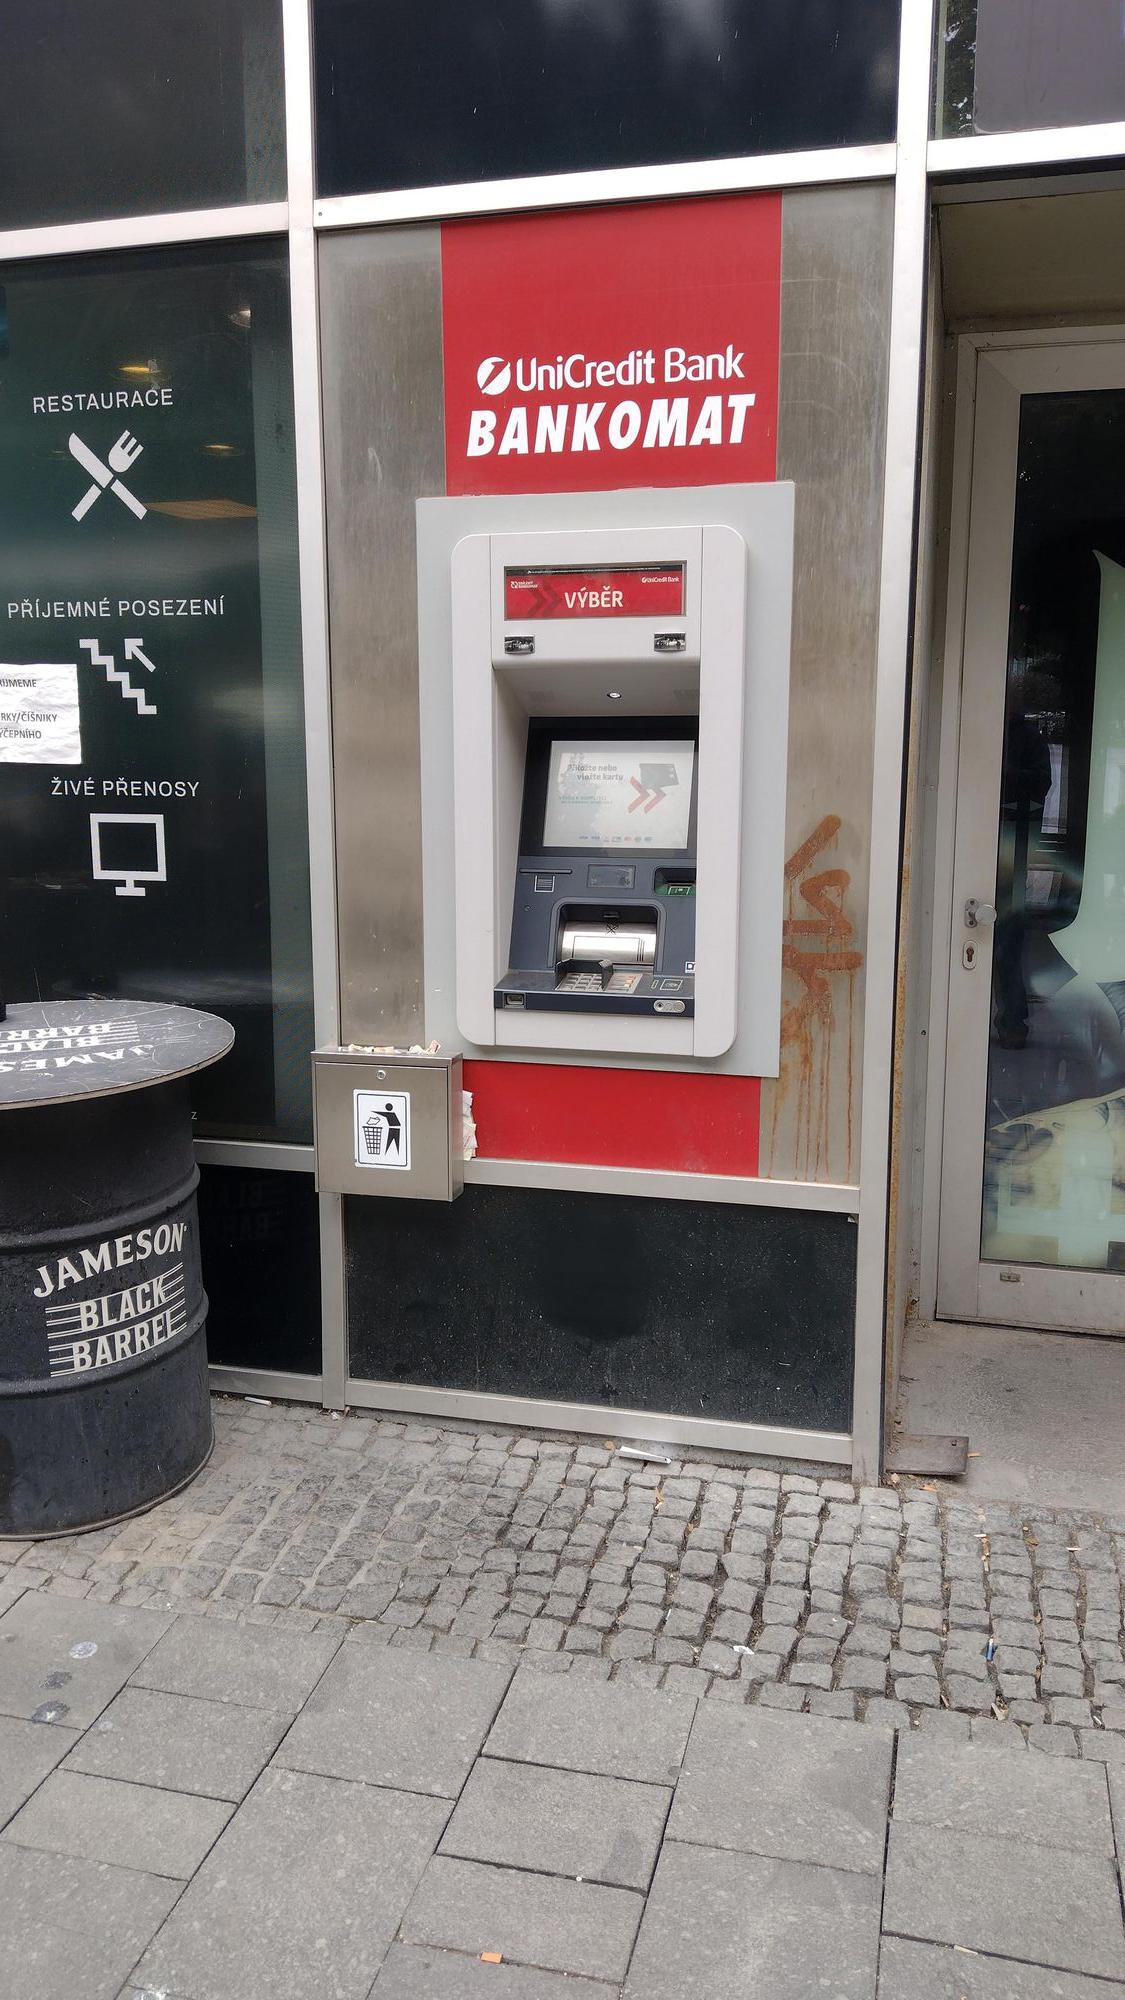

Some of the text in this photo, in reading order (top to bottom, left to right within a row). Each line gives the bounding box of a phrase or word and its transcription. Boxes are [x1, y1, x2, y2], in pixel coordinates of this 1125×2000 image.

[516, 344, 745, 391] UniCredit Bank
[33, 388, 173, 413] RESTAURACE
[466, 393, 756, 457] BANKOMAT
[8, 595, 225, 618] PŘÍJEMNÉ POSEZENÍ
[565, 586, 624, 608] VÝBĚR
[51, 777, 200, 797] ŽIVÉ PŘENOSY
[0, 1022, 112, 1041] BARR
[33, 1223, 185, 1298] JAMESON
[79, 1275, 167, 1332] BLACK
[72, 1310, 177, 1373] BARREL
